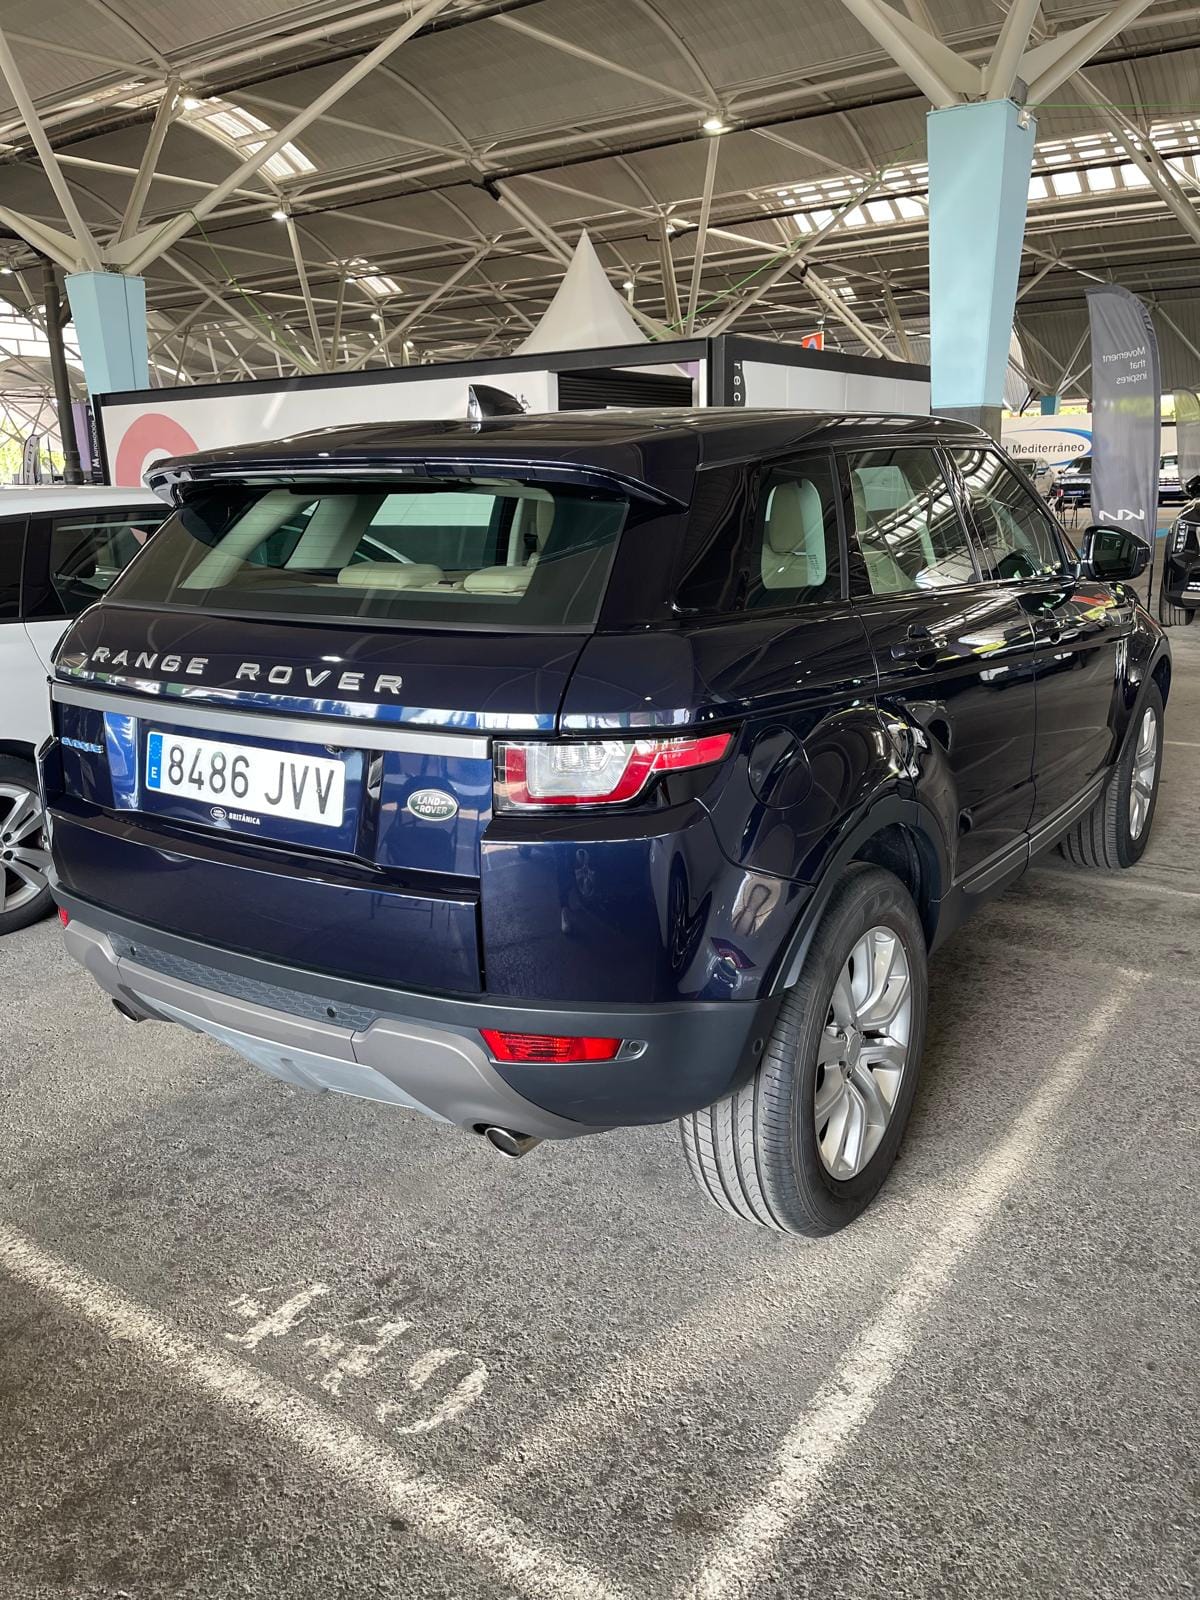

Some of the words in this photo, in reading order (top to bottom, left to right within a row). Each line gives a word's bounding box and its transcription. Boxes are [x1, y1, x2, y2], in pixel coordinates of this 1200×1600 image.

[1012, 442, 1085, 454] Mediterráneo
[90, 646, 209, 675] RANGE
[235, 661, 403, 695] ROVER
[151, 767, 158, 779] E
[168, 744, 250, 798] 8486
[264, 761, 335, 815] JVV
[417, 796, 441, 806] LAND
[419, 805, 448, 814] ROVER
[228, 812, 261, 826] BRITÁNICA
